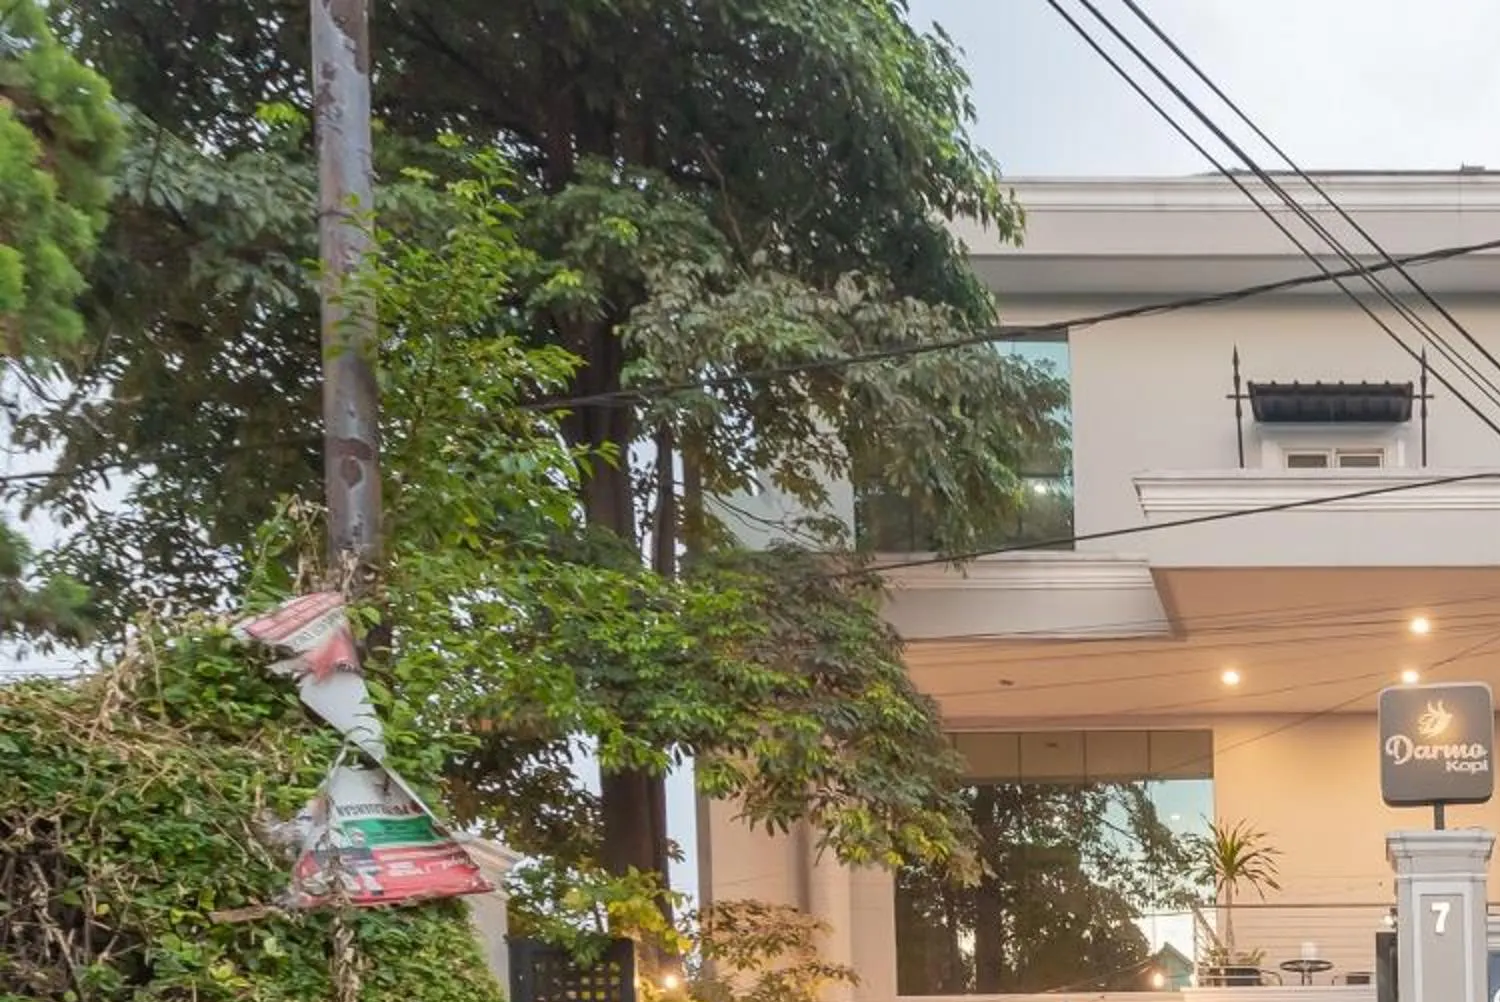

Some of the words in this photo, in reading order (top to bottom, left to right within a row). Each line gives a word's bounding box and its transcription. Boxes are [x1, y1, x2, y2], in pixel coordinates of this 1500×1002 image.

[1385, 734, 1488, 765] Darmo
[1445, 759, 1488, 774] Kopi
[1431, 901, 1450, 933] 7
